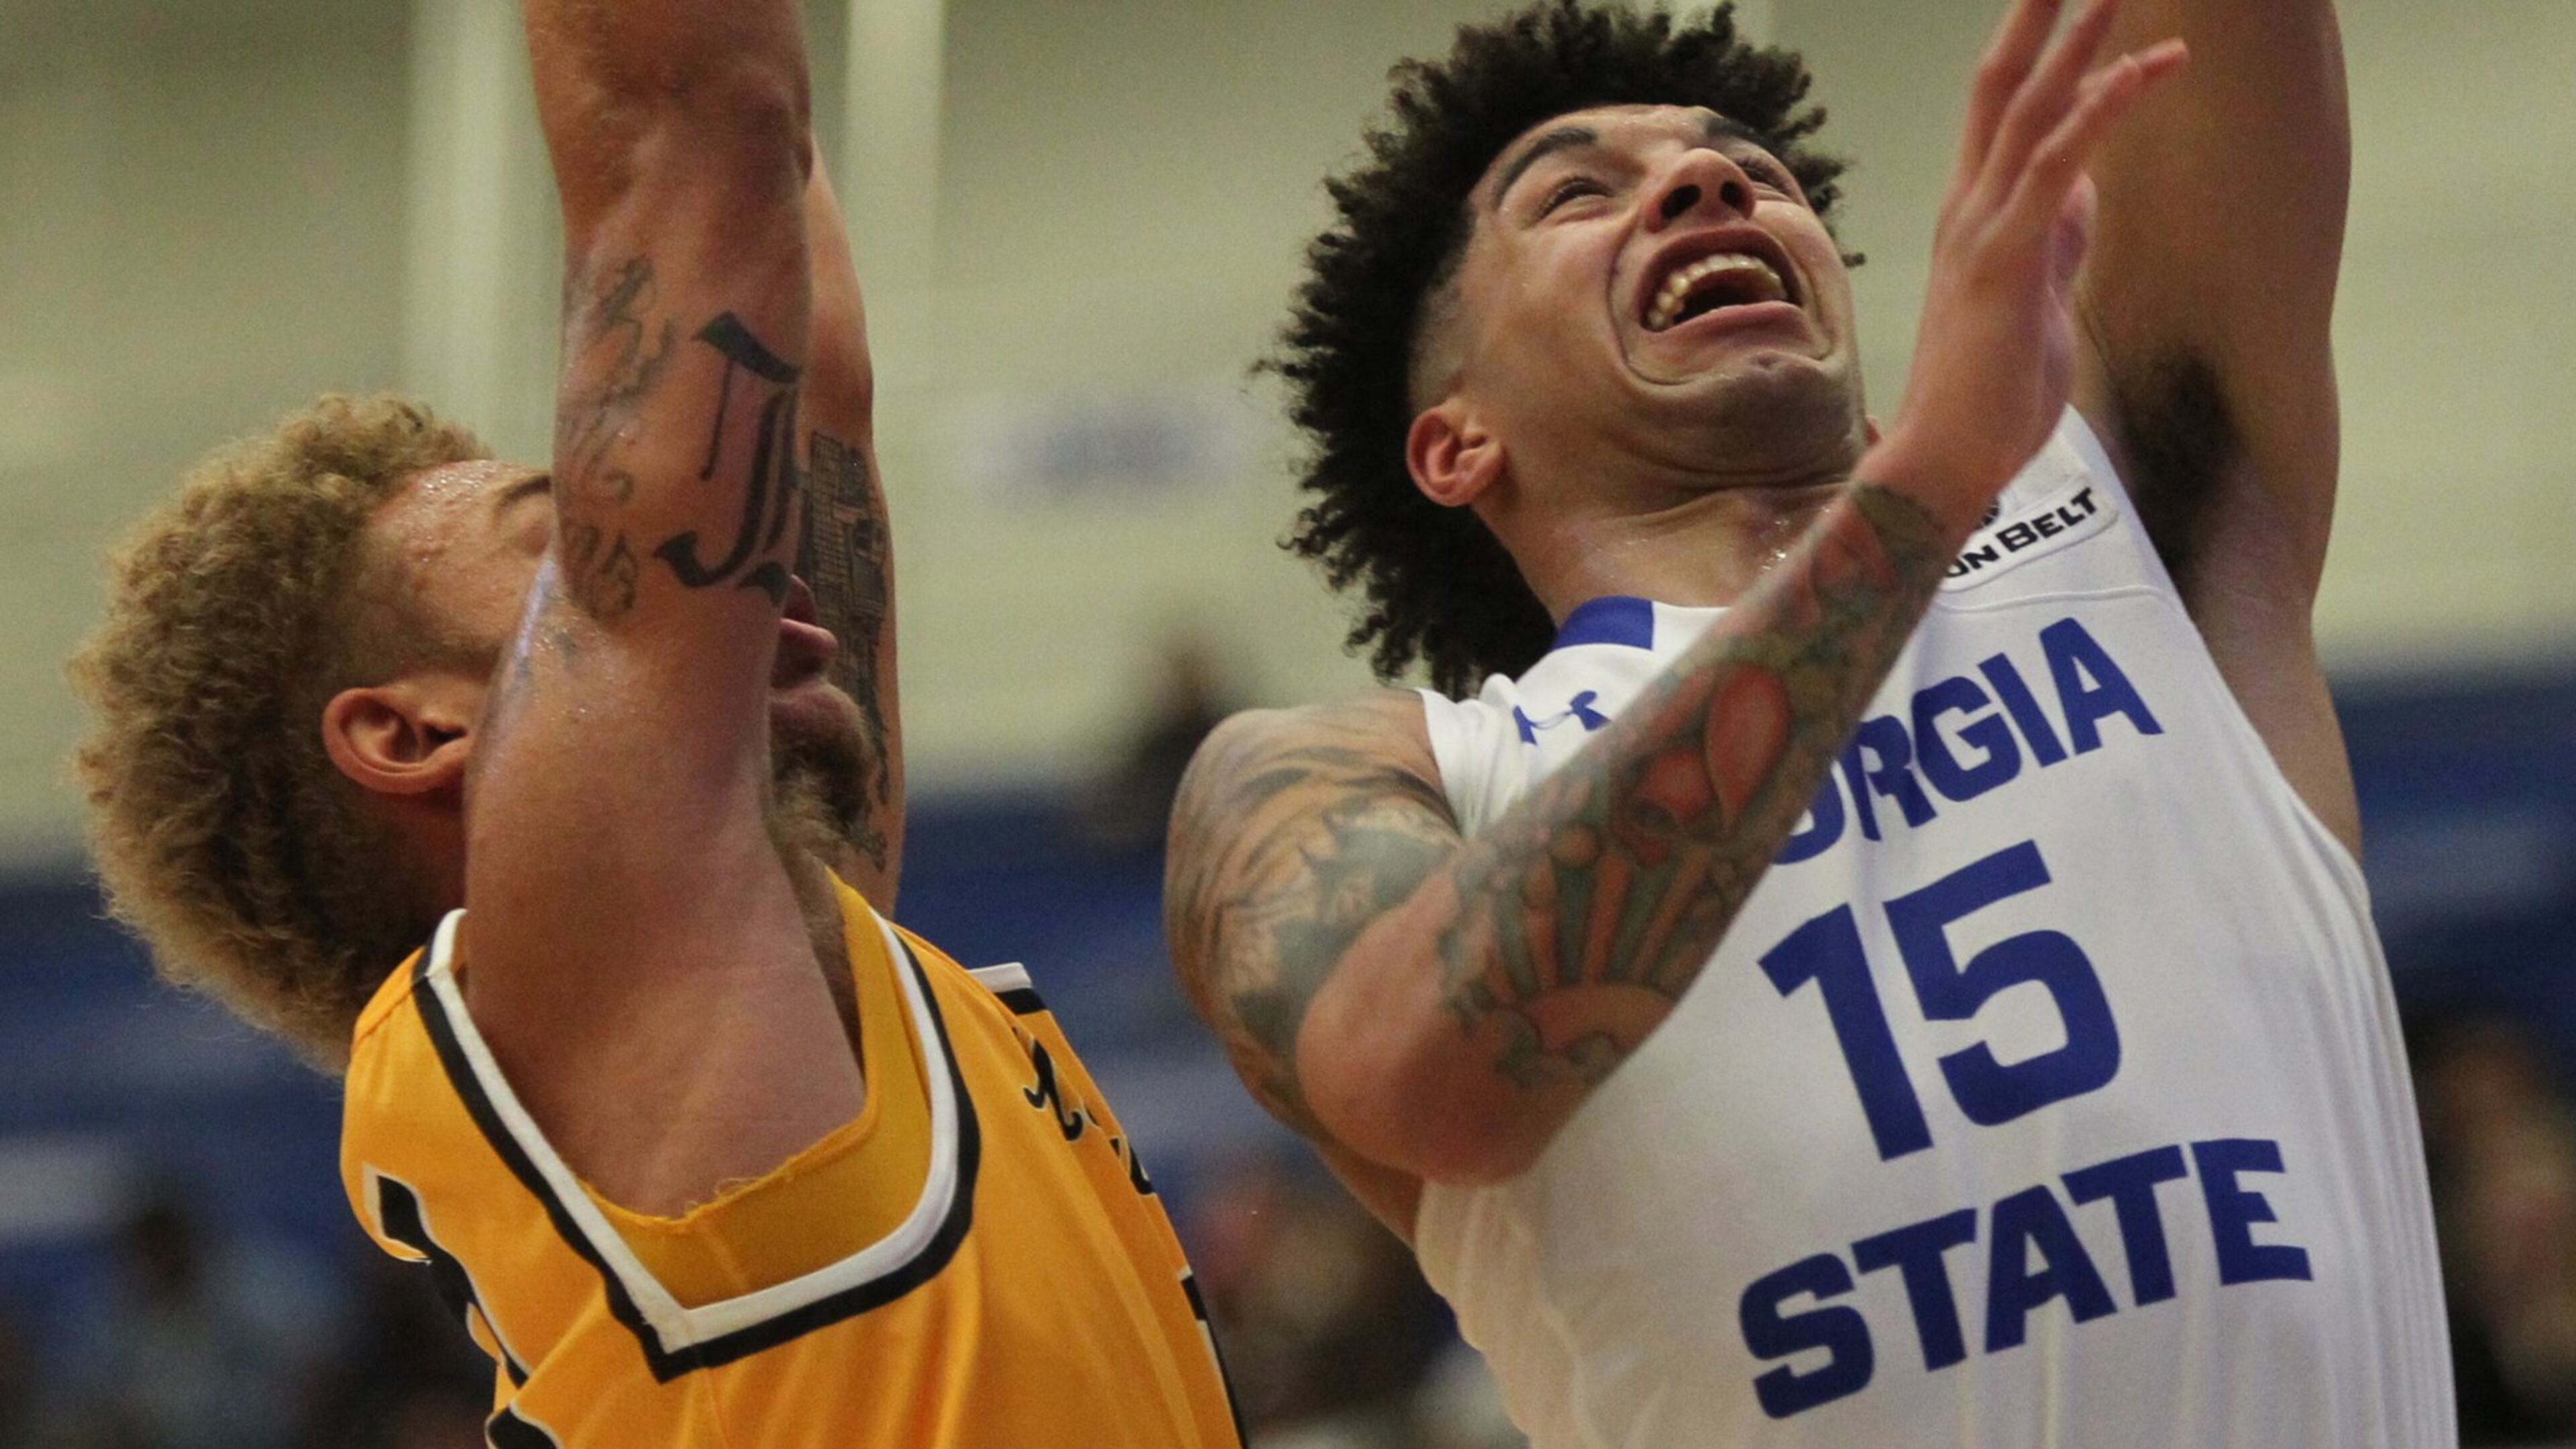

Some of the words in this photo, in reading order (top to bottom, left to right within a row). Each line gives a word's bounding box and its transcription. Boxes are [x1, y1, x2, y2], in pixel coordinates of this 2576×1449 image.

[1943, 544, 2001, 578] UN
[1995, 486, 2097, 553] BELT
[1770, 617, 2164, 865] ORGIA
[1757, 839, 2121, 1162] 15
[1738, 1137, 2314, 1419] STATE
